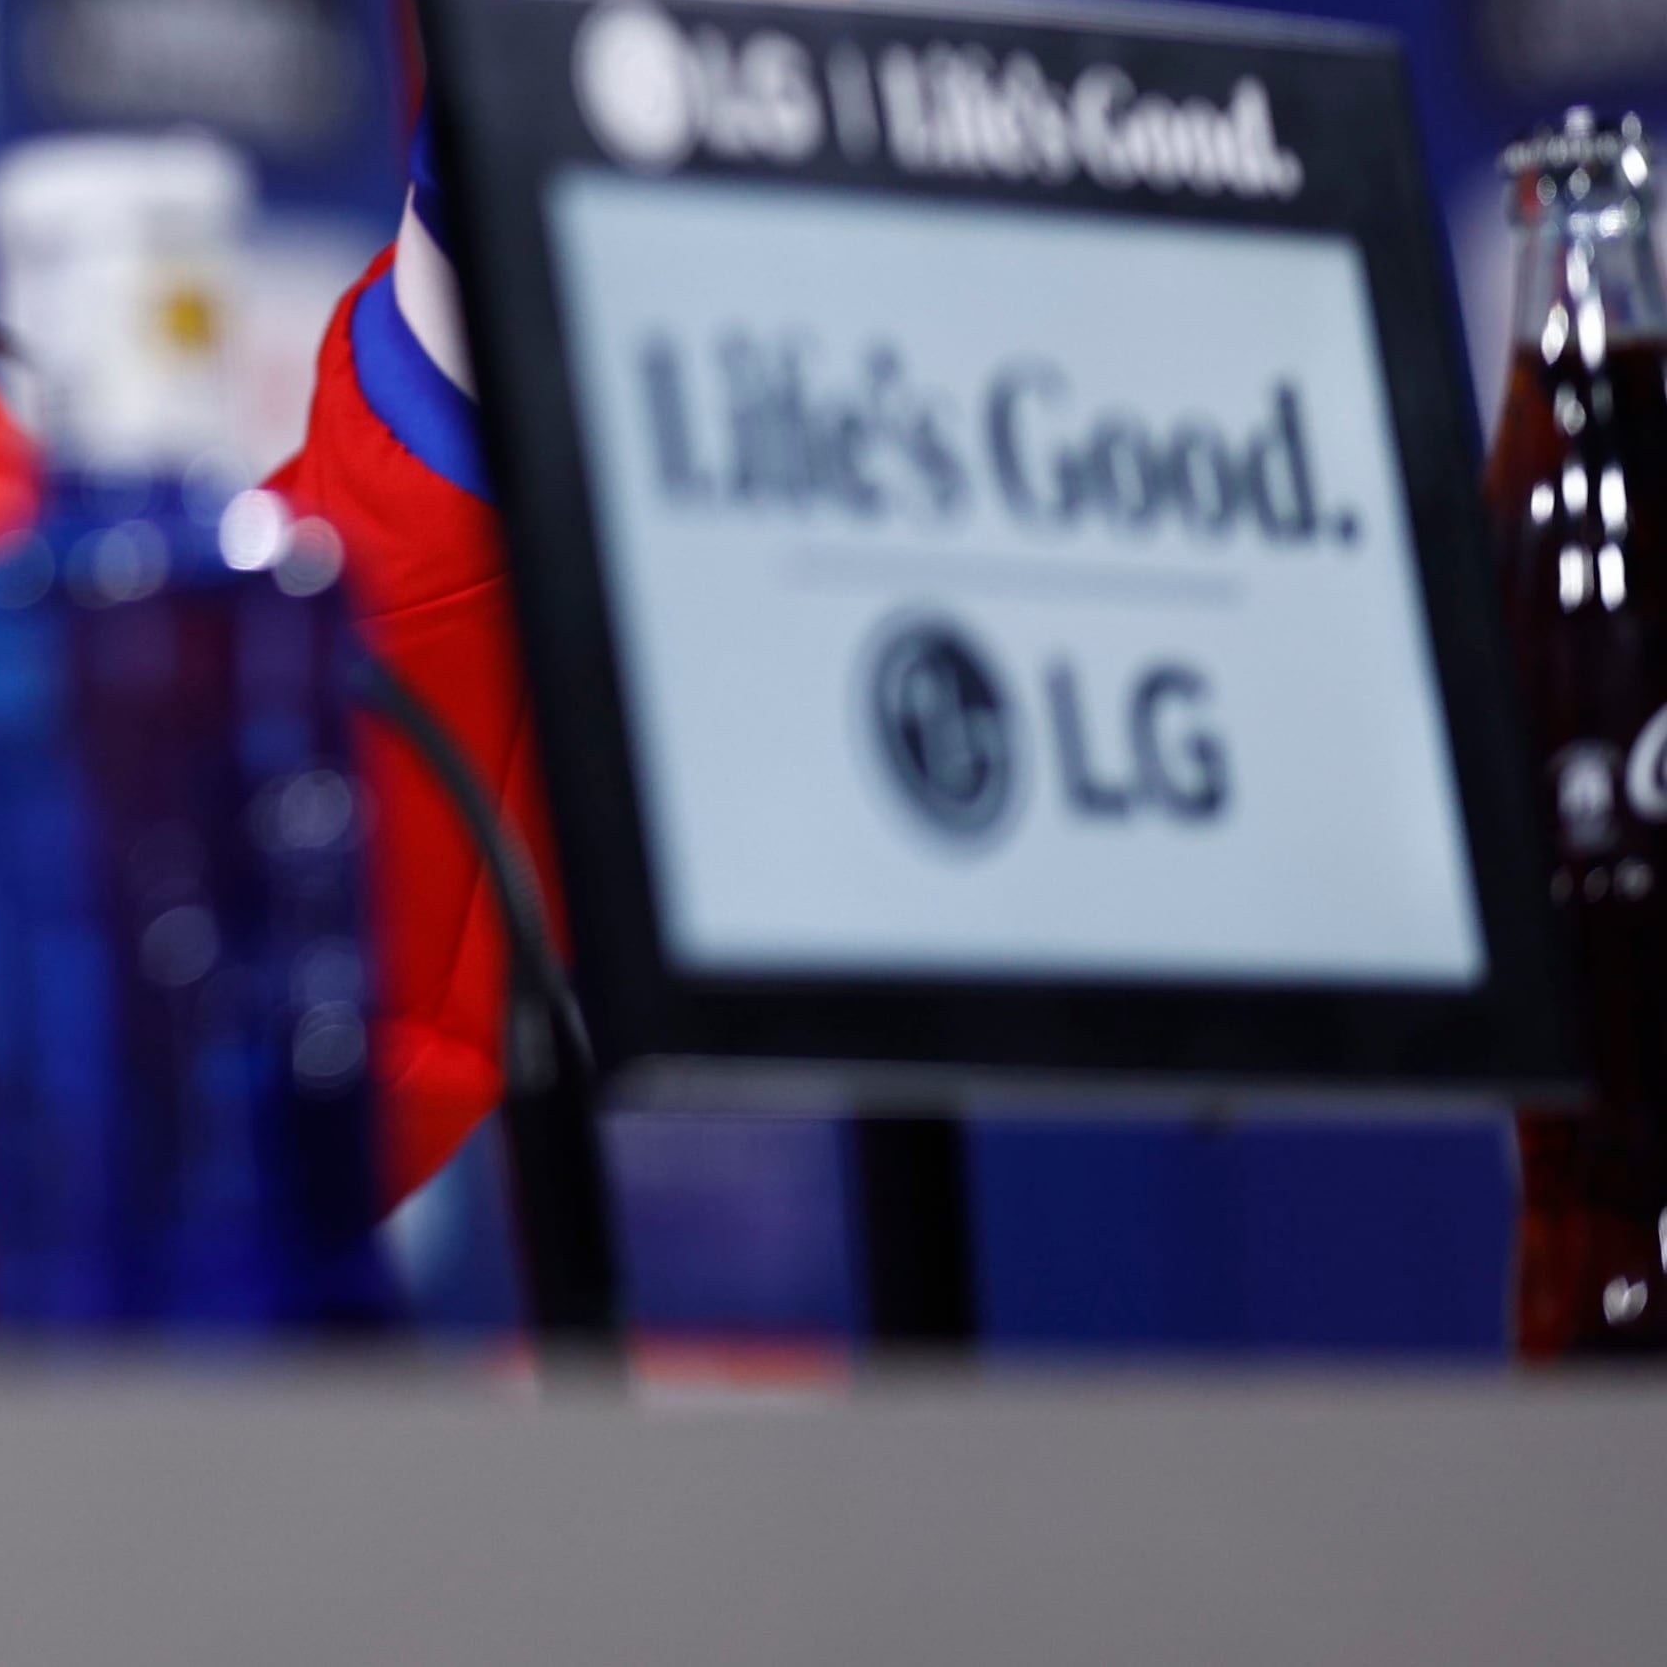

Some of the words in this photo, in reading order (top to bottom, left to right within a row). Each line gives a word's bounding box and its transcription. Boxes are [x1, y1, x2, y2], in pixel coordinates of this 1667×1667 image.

[693, 24, 822, 164] LG
[639, 327, 971, 518] Life's
[979, 350, 1364, 553] Good.
[1042, 649, 1234, 826] LG
